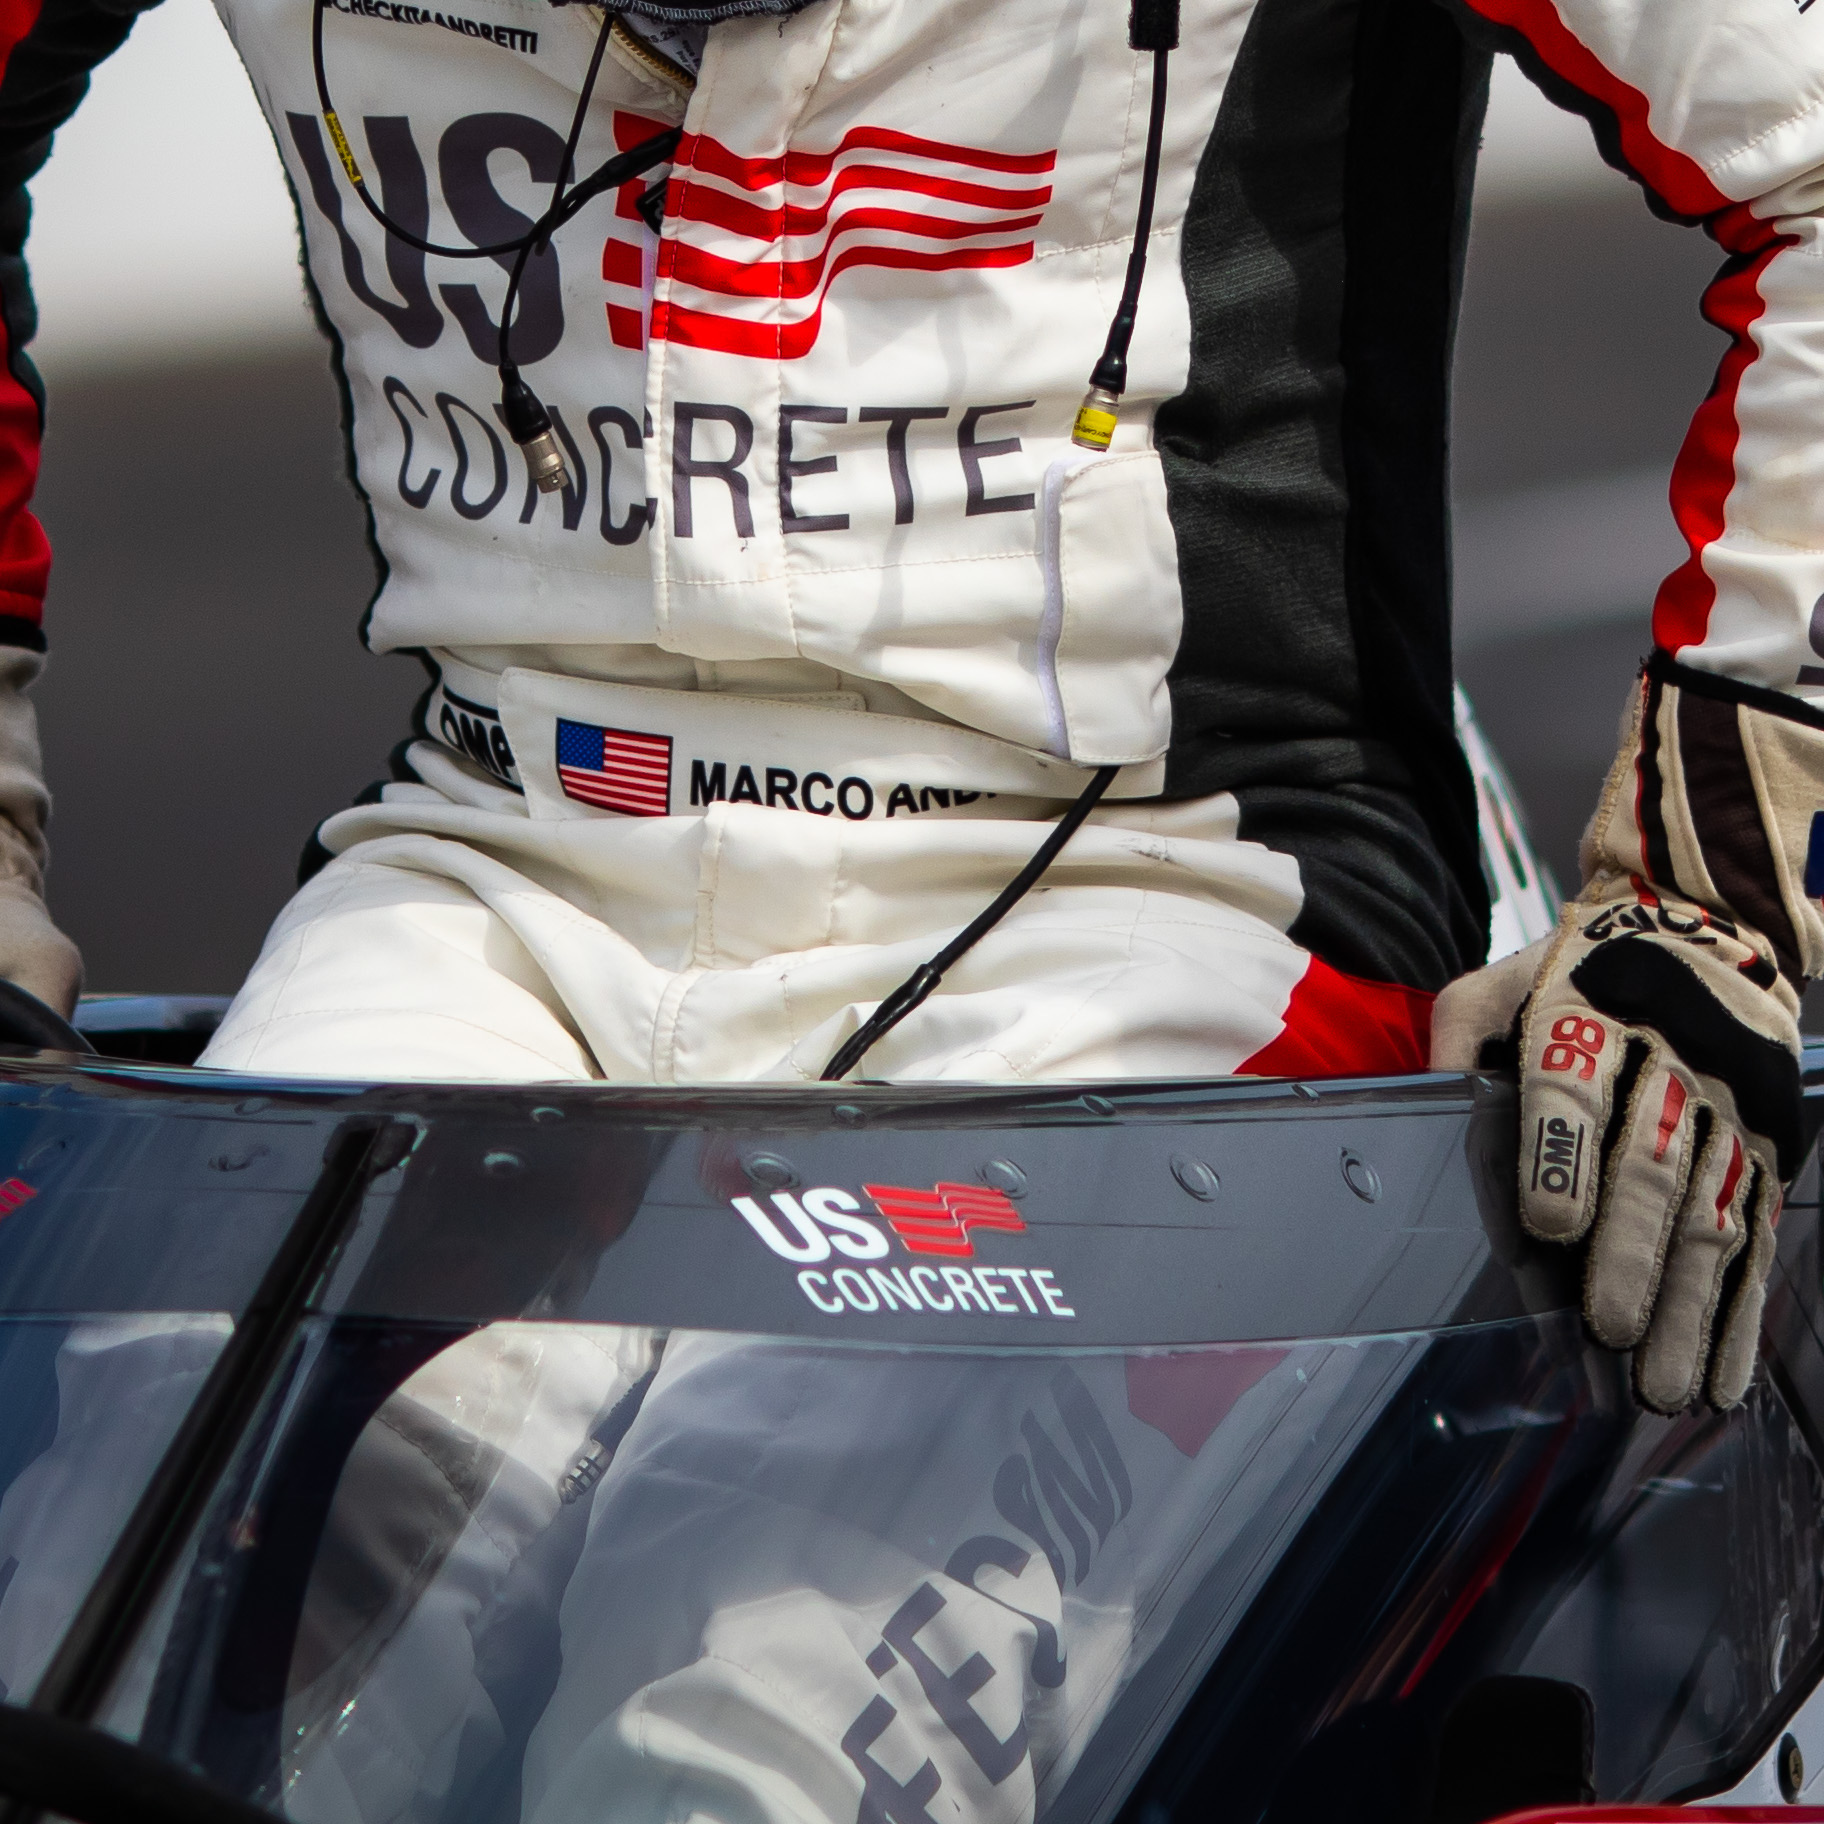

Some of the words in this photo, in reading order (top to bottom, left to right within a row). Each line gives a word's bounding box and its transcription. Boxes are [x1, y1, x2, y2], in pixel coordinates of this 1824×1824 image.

[285, 111, 574, 367] US
[382, 376, 1036, 547] CONCRETE
[690, 759, 874, 822] MARCO
[886, 780, 998, 819] AND
[1540, 1014, 1607, 1082] 98
[1540, 1116, 1577, 1195] OMP
[729, 1186, 890, 1263] US
[797, 1266, 1076, 1318] CONCRETE
